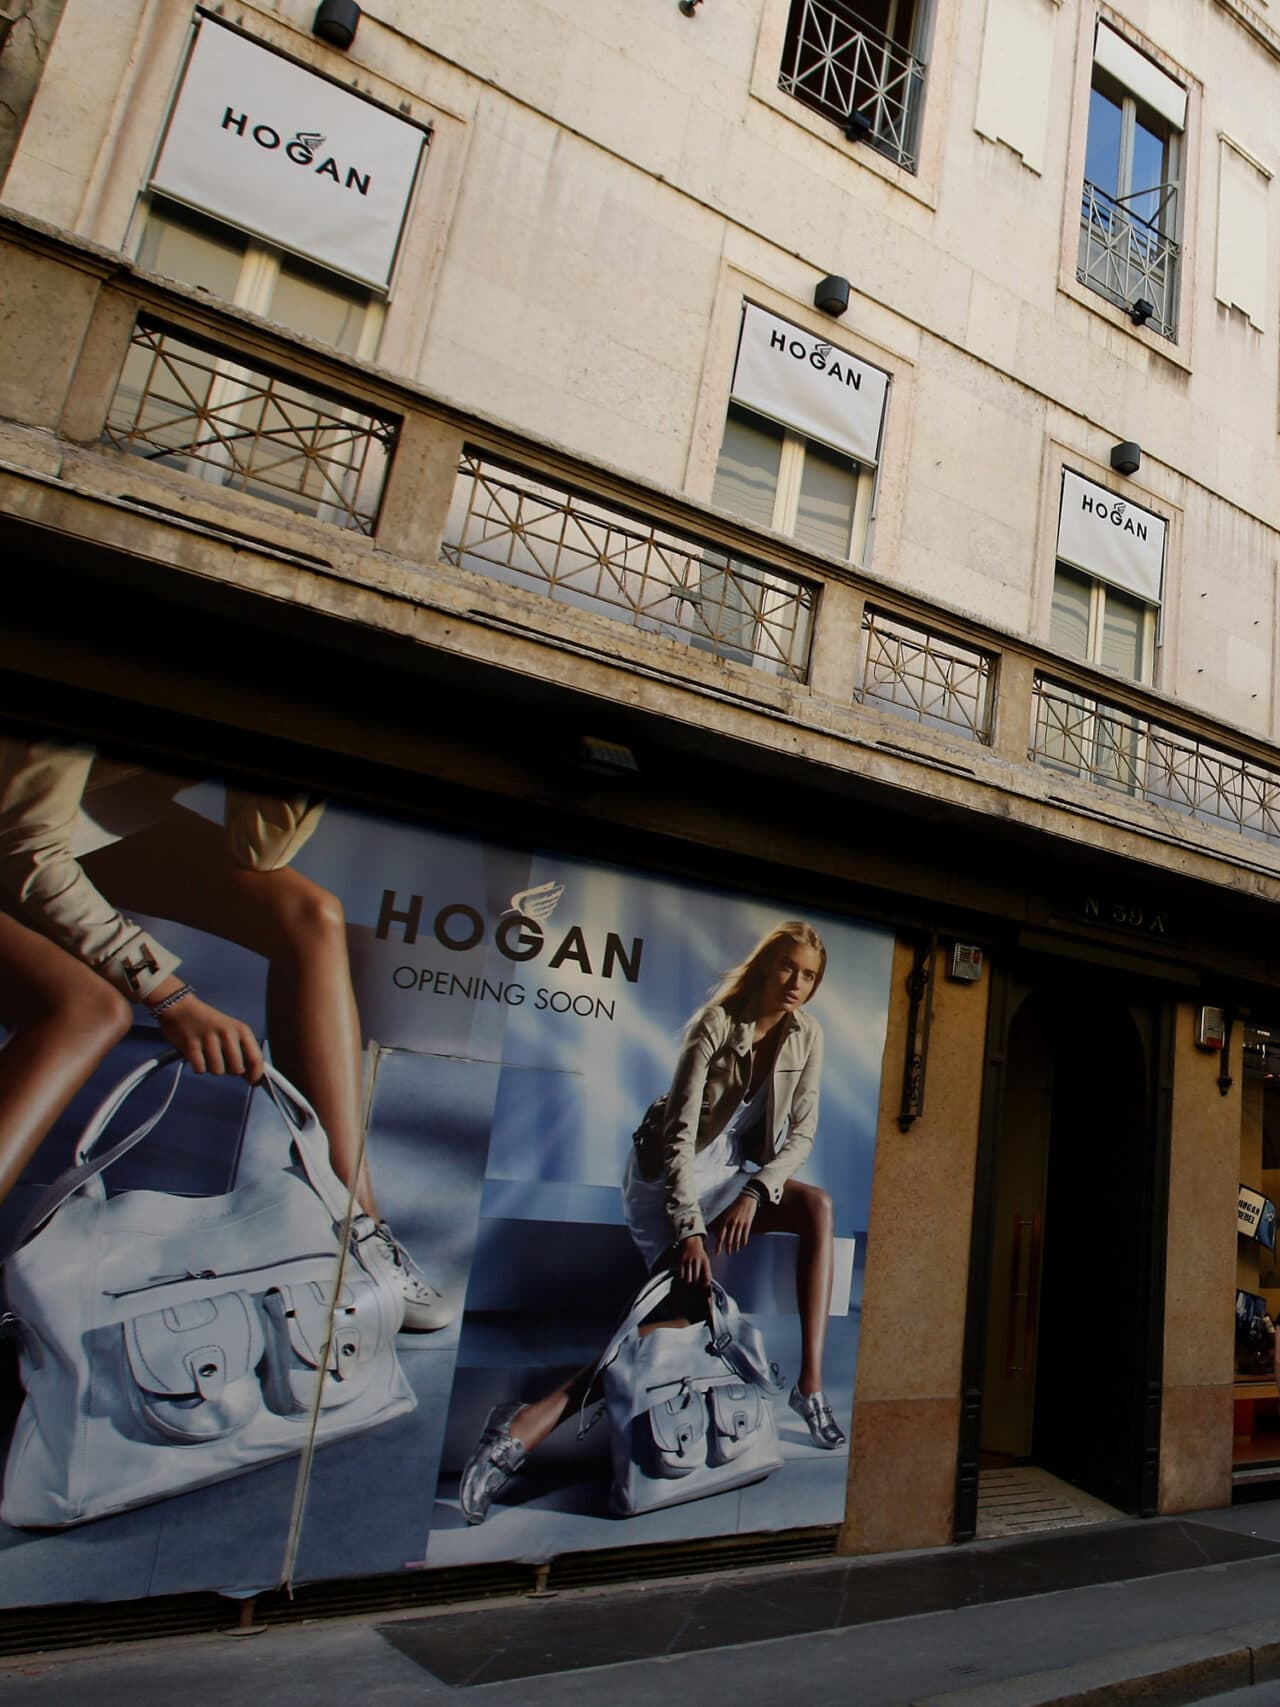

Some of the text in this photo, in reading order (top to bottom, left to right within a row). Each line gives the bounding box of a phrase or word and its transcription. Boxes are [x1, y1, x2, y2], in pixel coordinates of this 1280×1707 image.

[221, 106, 371, 196] HOGAN
[769, 329, 862, 391] HOGAN
[1081, 494, 1148, 541] HOGAN
[375, 889, 644, 983] HOGAN
[392, 966, 616, 1020] OPENING SOON
